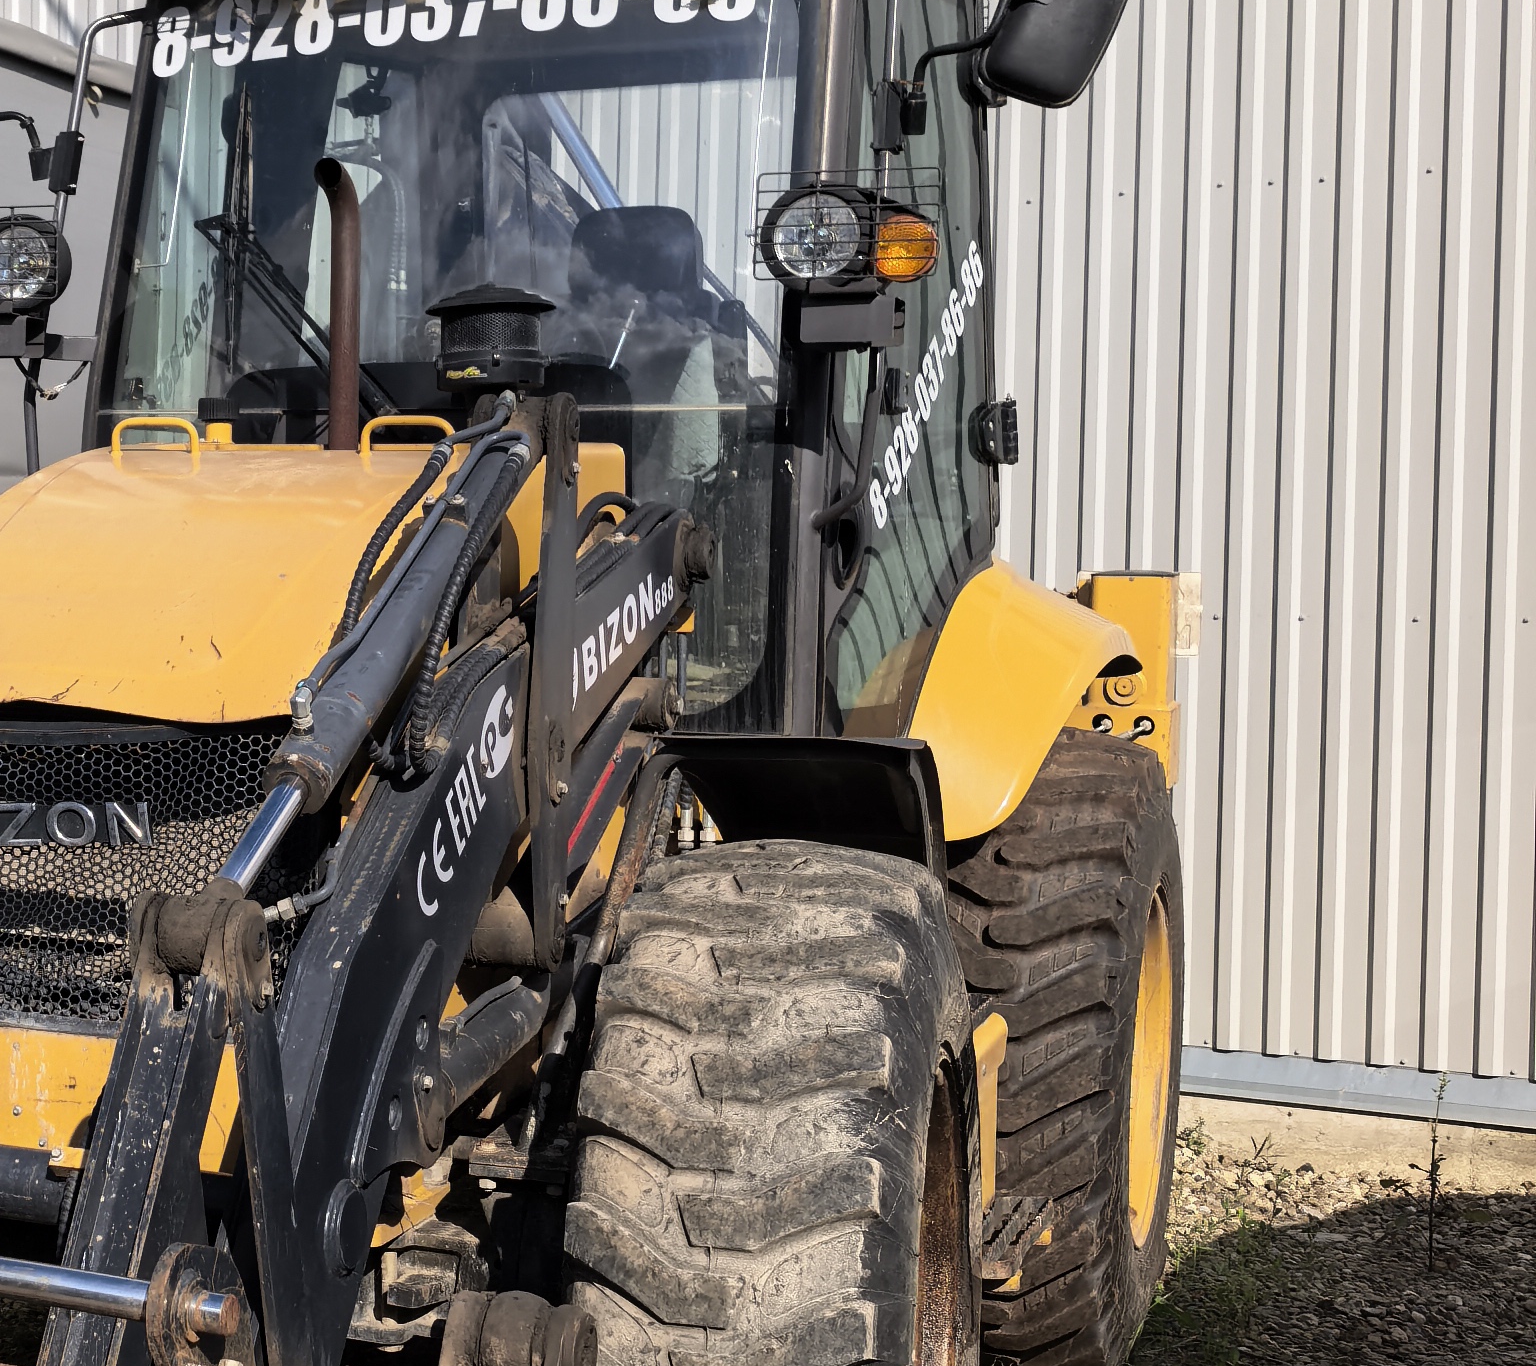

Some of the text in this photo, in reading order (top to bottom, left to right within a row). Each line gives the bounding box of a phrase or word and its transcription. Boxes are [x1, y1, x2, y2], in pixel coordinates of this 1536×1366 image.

[869, 240, 985, 529] 8-928-037-86-86
[581, 572, 674, 692] BIZON 888
[417, 818, 454, 917] CE
